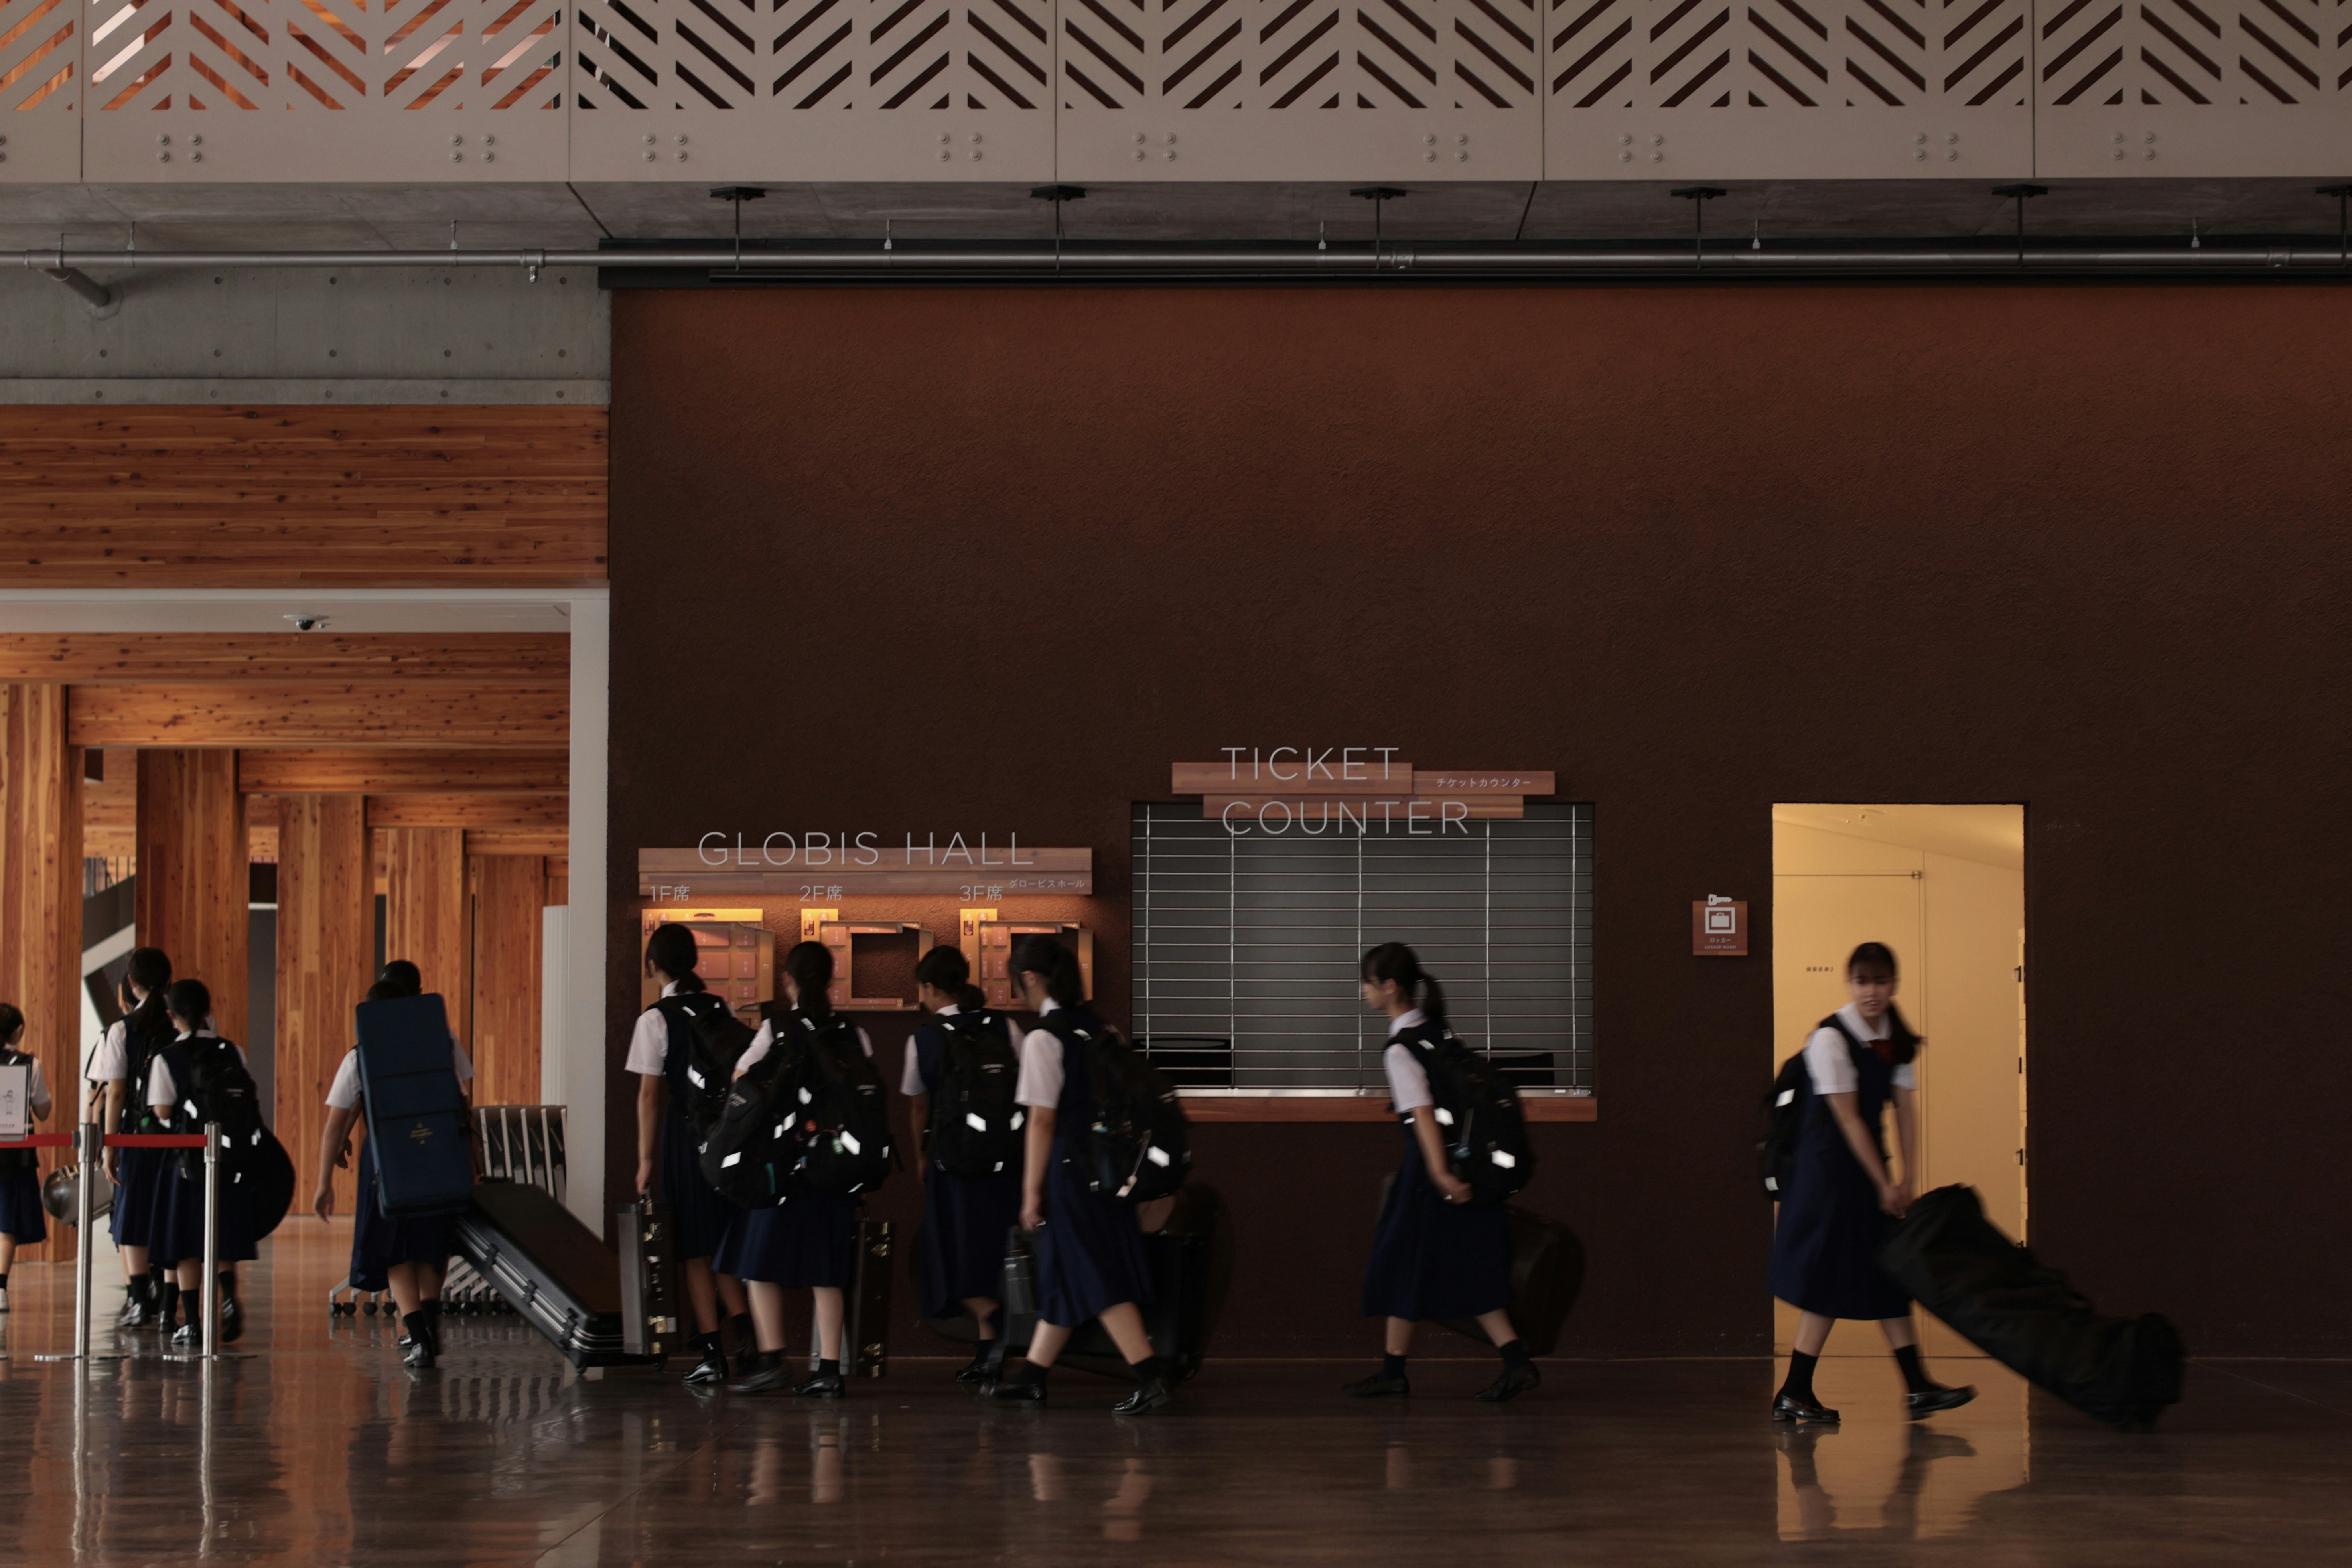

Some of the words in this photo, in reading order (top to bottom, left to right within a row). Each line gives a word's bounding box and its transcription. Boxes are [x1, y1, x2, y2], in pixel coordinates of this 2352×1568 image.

[1221, 746, 1399, 781] TICKET
[1436, 777, 1531, 788] チケットカウンター
[1222, 801, 1469, 835] COUNTER
[698, 831, 879, 865] GLOBIS
[907, 832, 1034, 865] HALL
[1009, 879, 1085, 888] グロービスホール
[649, 884, 690, 902] 1F席
[799, 884, 843, 902] 2F席
[959, 884, 1003, 902] 3F席
